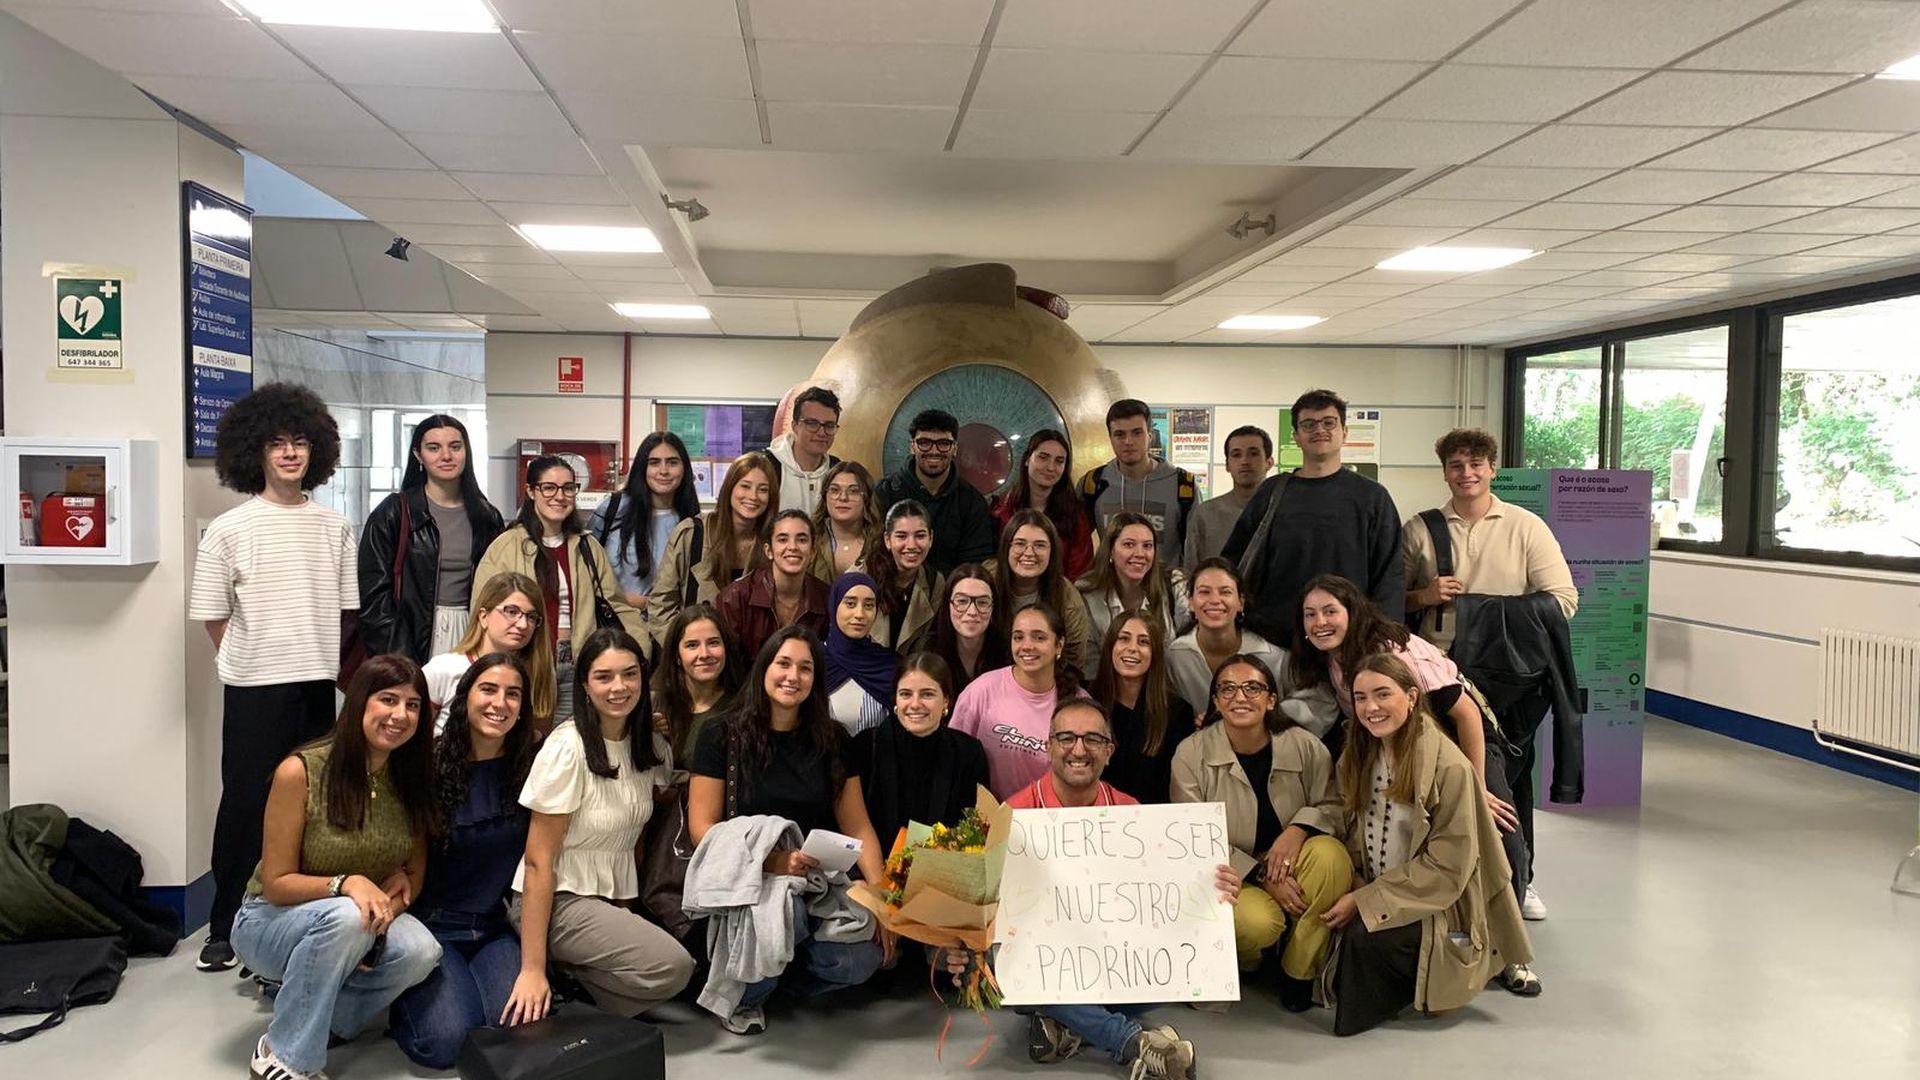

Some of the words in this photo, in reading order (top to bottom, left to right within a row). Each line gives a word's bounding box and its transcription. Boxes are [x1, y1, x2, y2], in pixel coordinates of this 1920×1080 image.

[61, 349, 119, 357] DESFIBRILADOR
[1165, 821, 1227, 860] SER
[1054, 881, 1181, 925] NUESTRO
